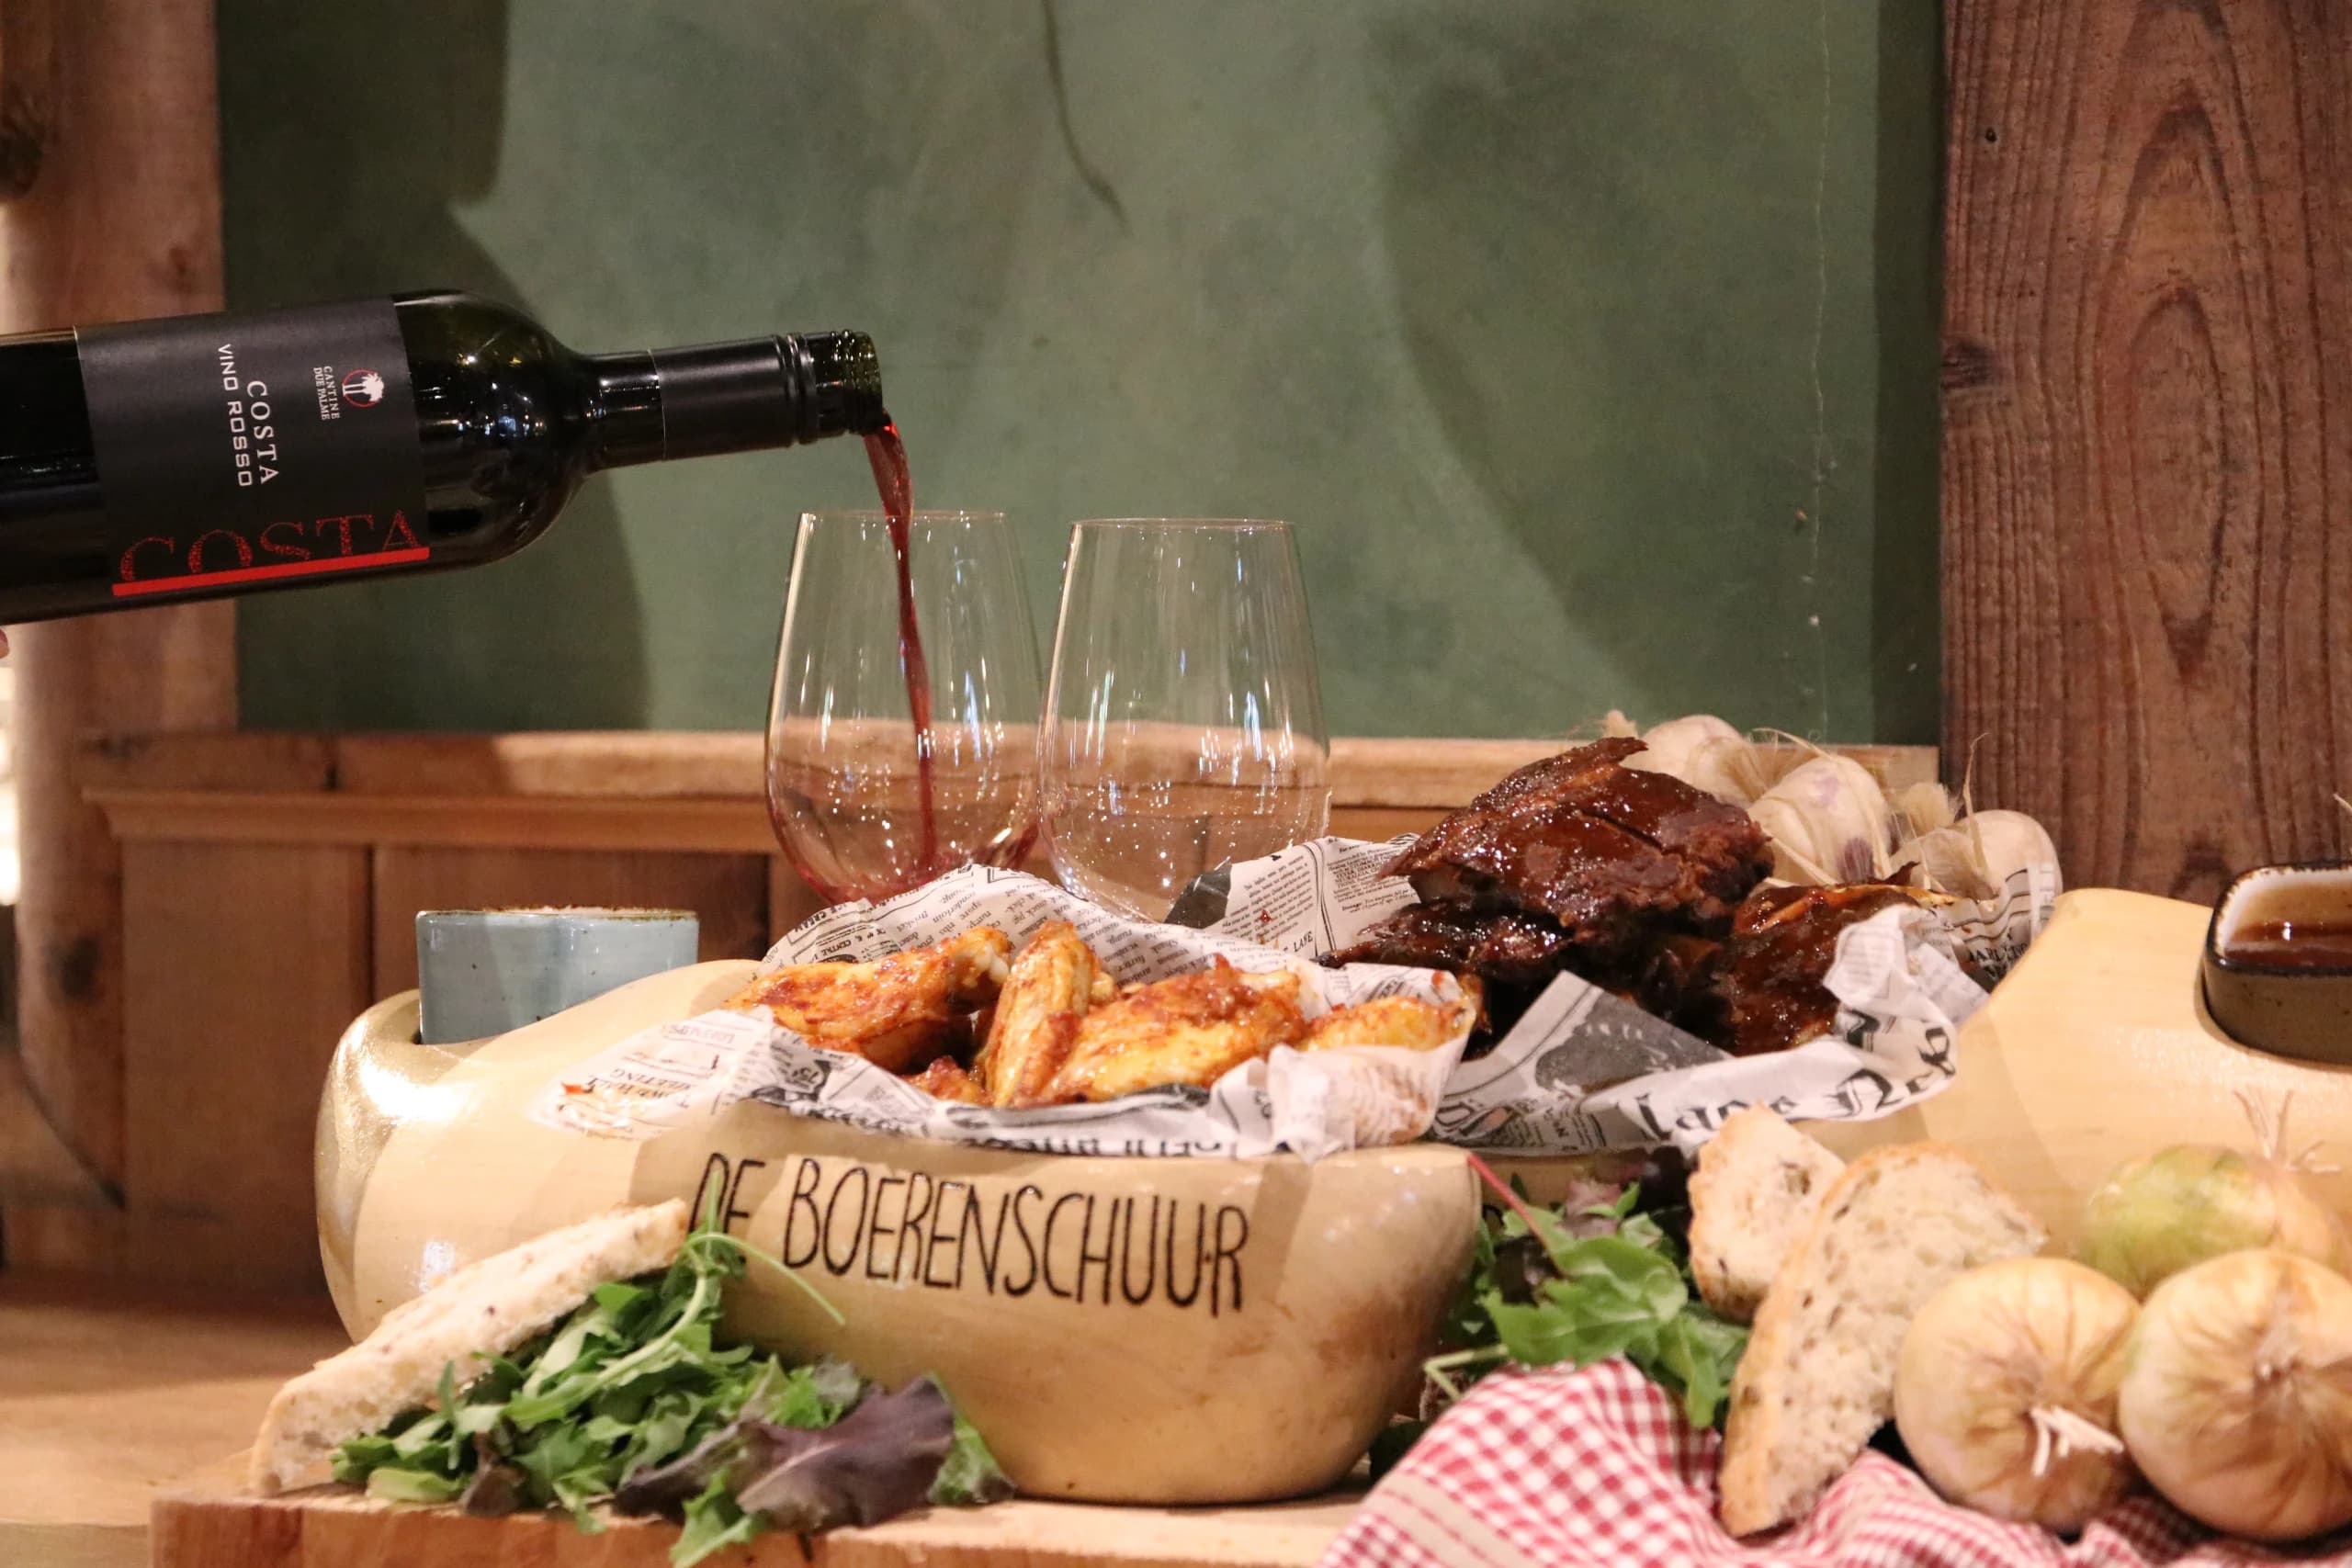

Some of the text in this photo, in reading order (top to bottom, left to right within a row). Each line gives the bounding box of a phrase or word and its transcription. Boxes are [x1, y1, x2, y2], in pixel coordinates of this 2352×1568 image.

[218, 344, 253, 486] VINO ROSSO
[247, 380, 279, 485] COSTA
[313, 367, 331, 421] DUE PALME
[323, 366, 340, 420] CANTINE
[119, 509, 422, 581] COSTA
[687, 1152, 1250, 1318] DE BOERENSCHUUR
